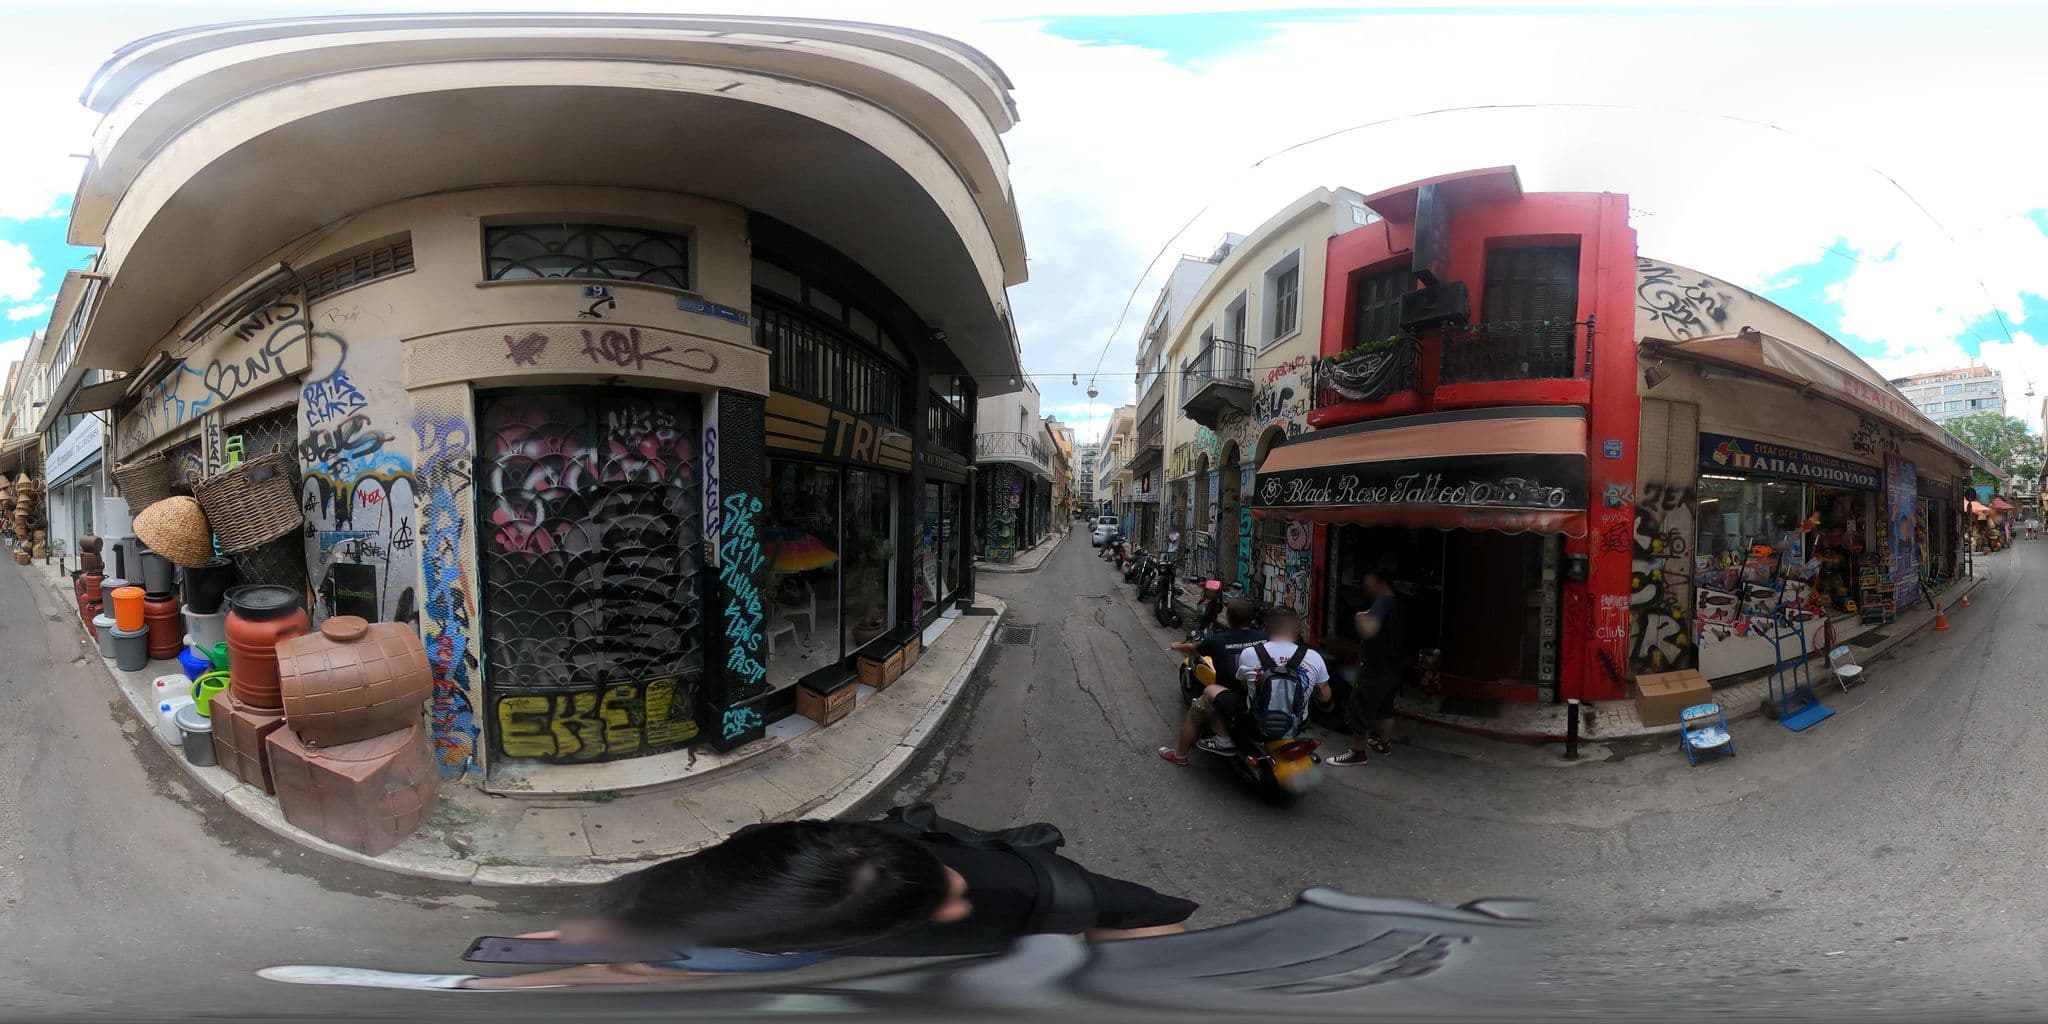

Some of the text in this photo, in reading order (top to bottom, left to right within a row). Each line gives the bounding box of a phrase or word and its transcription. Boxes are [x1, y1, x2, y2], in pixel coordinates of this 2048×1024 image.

[1733, 453, 1877, 487] ΠΑΠΑΔΟΠΟΥΛΟΣ
[1283, 472, 1467, 504] Black Rose Tattoo
